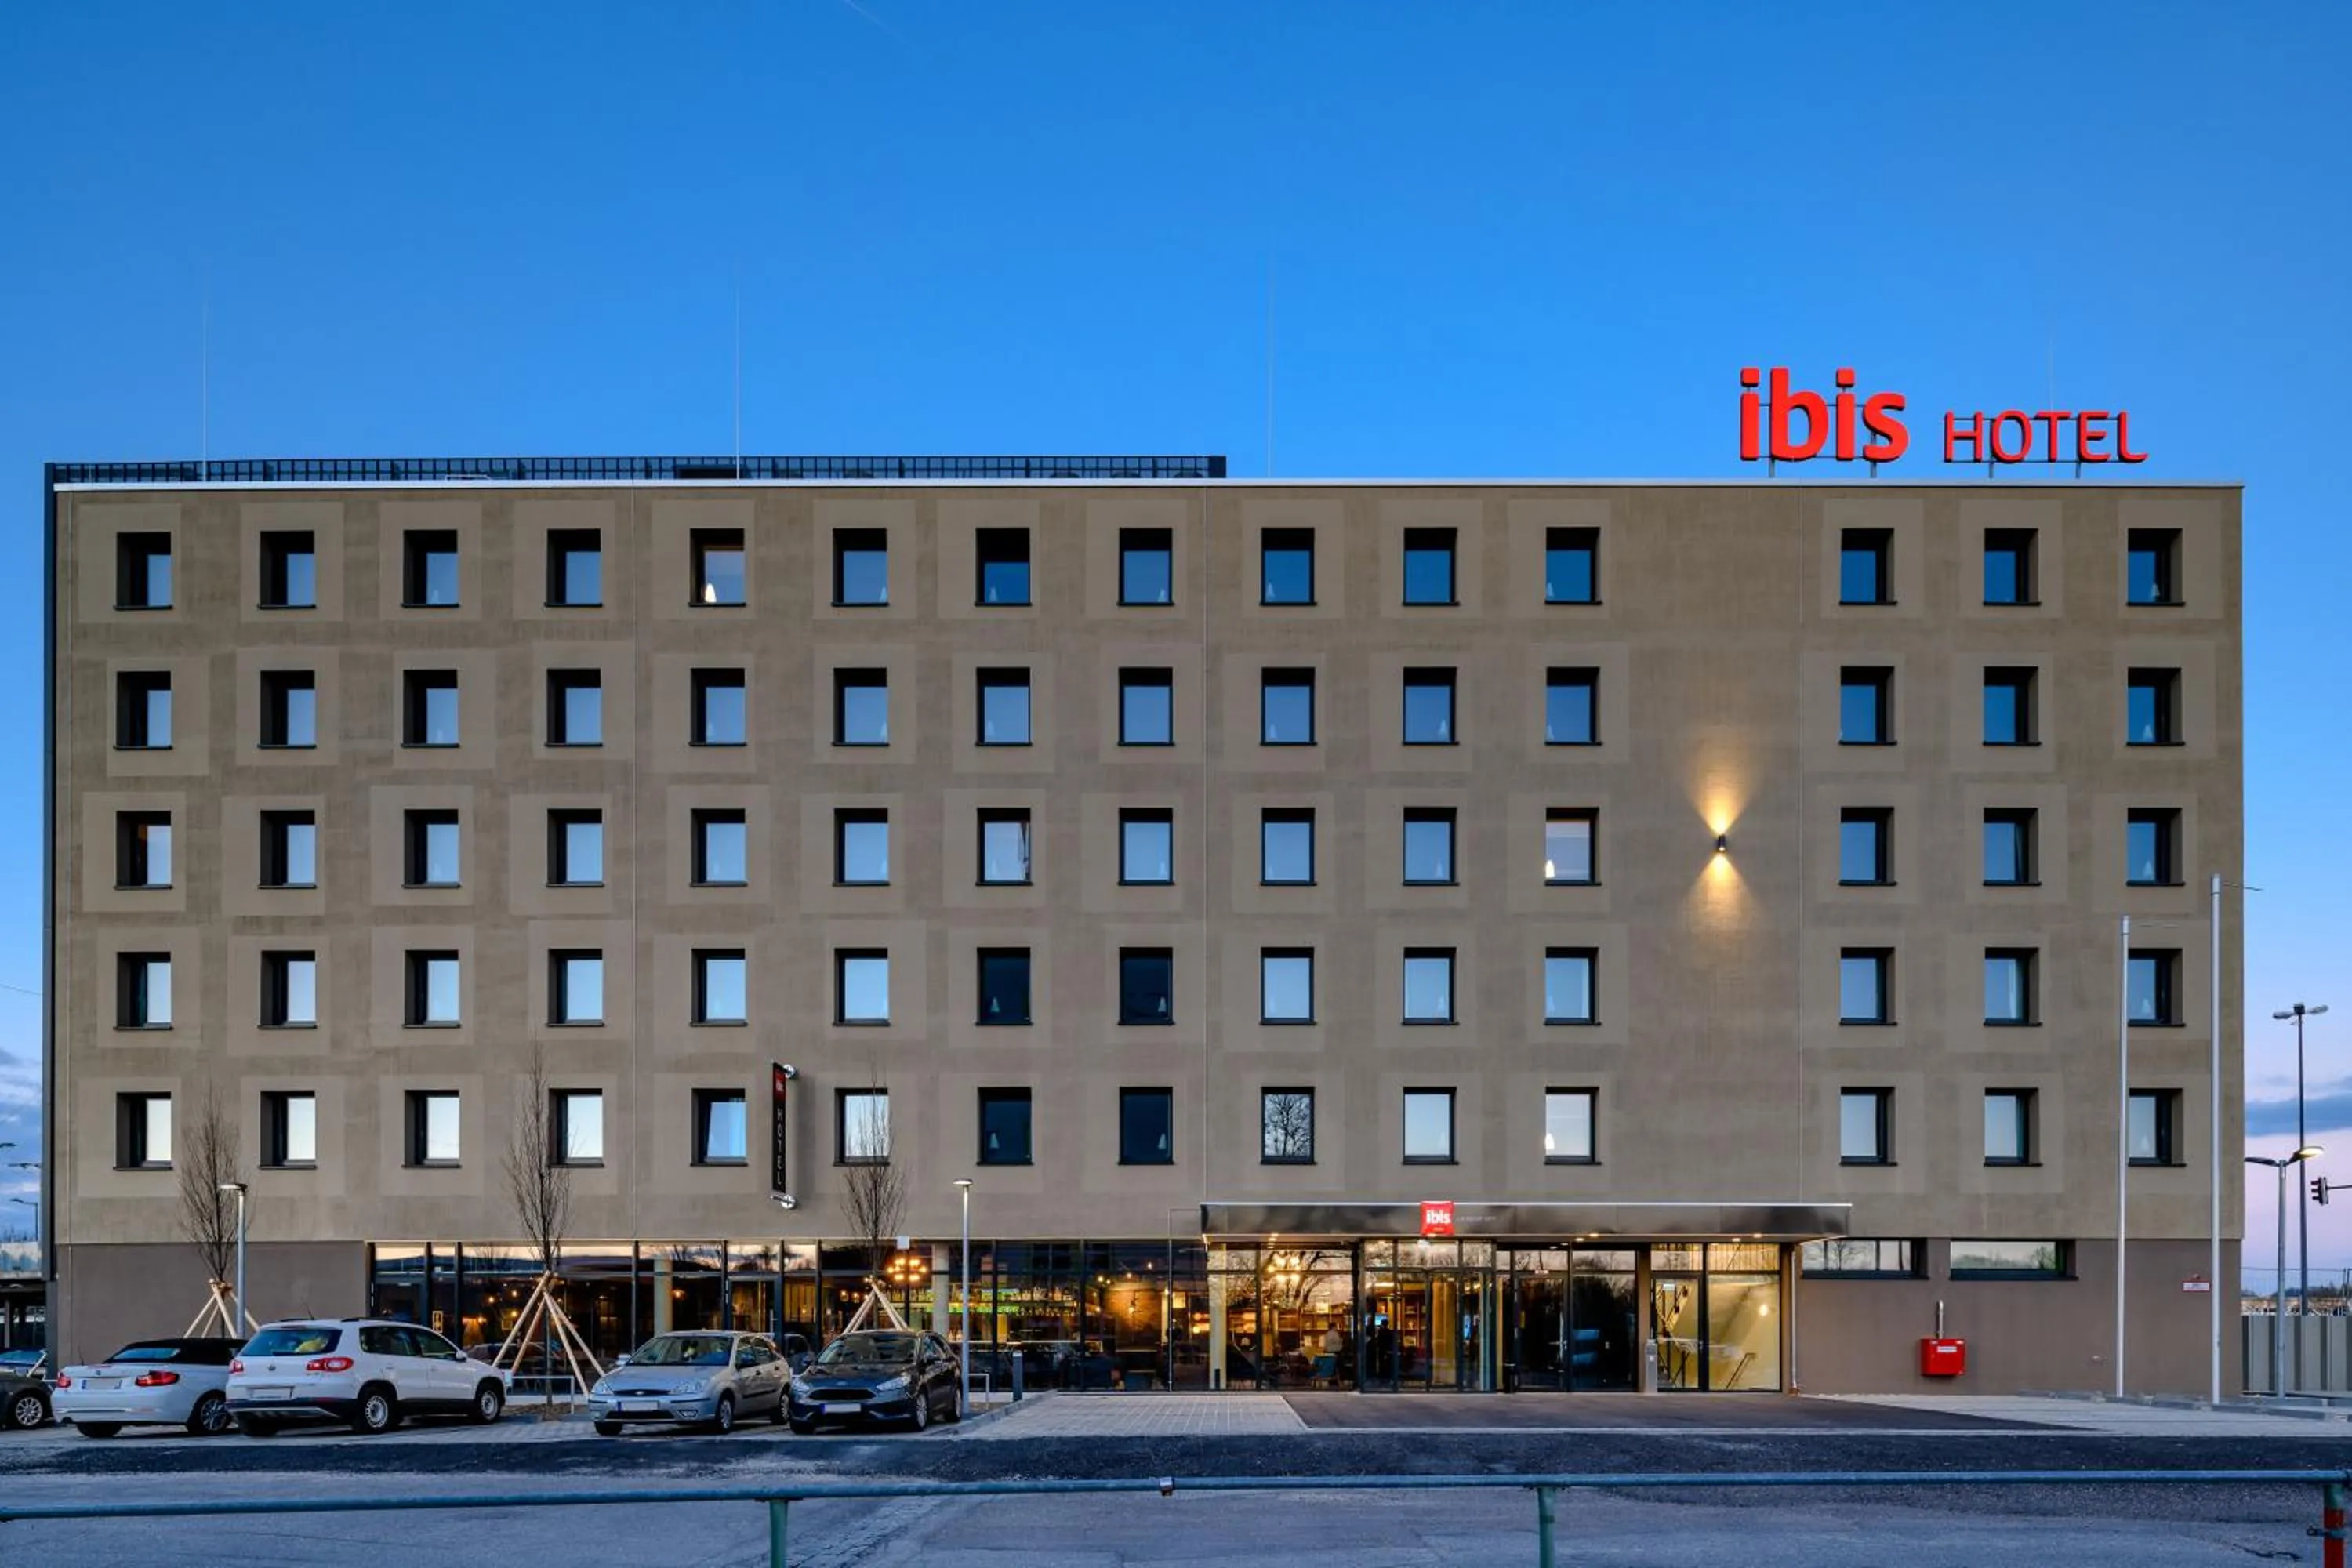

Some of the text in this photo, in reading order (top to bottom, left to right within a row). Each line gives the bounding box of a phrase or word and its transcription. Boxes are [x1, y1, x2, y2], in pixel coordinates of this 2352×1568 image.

[1740, 367, 2149, 464] ibis HOTEL
[1426, 1210, 1452, 1224] ibis
